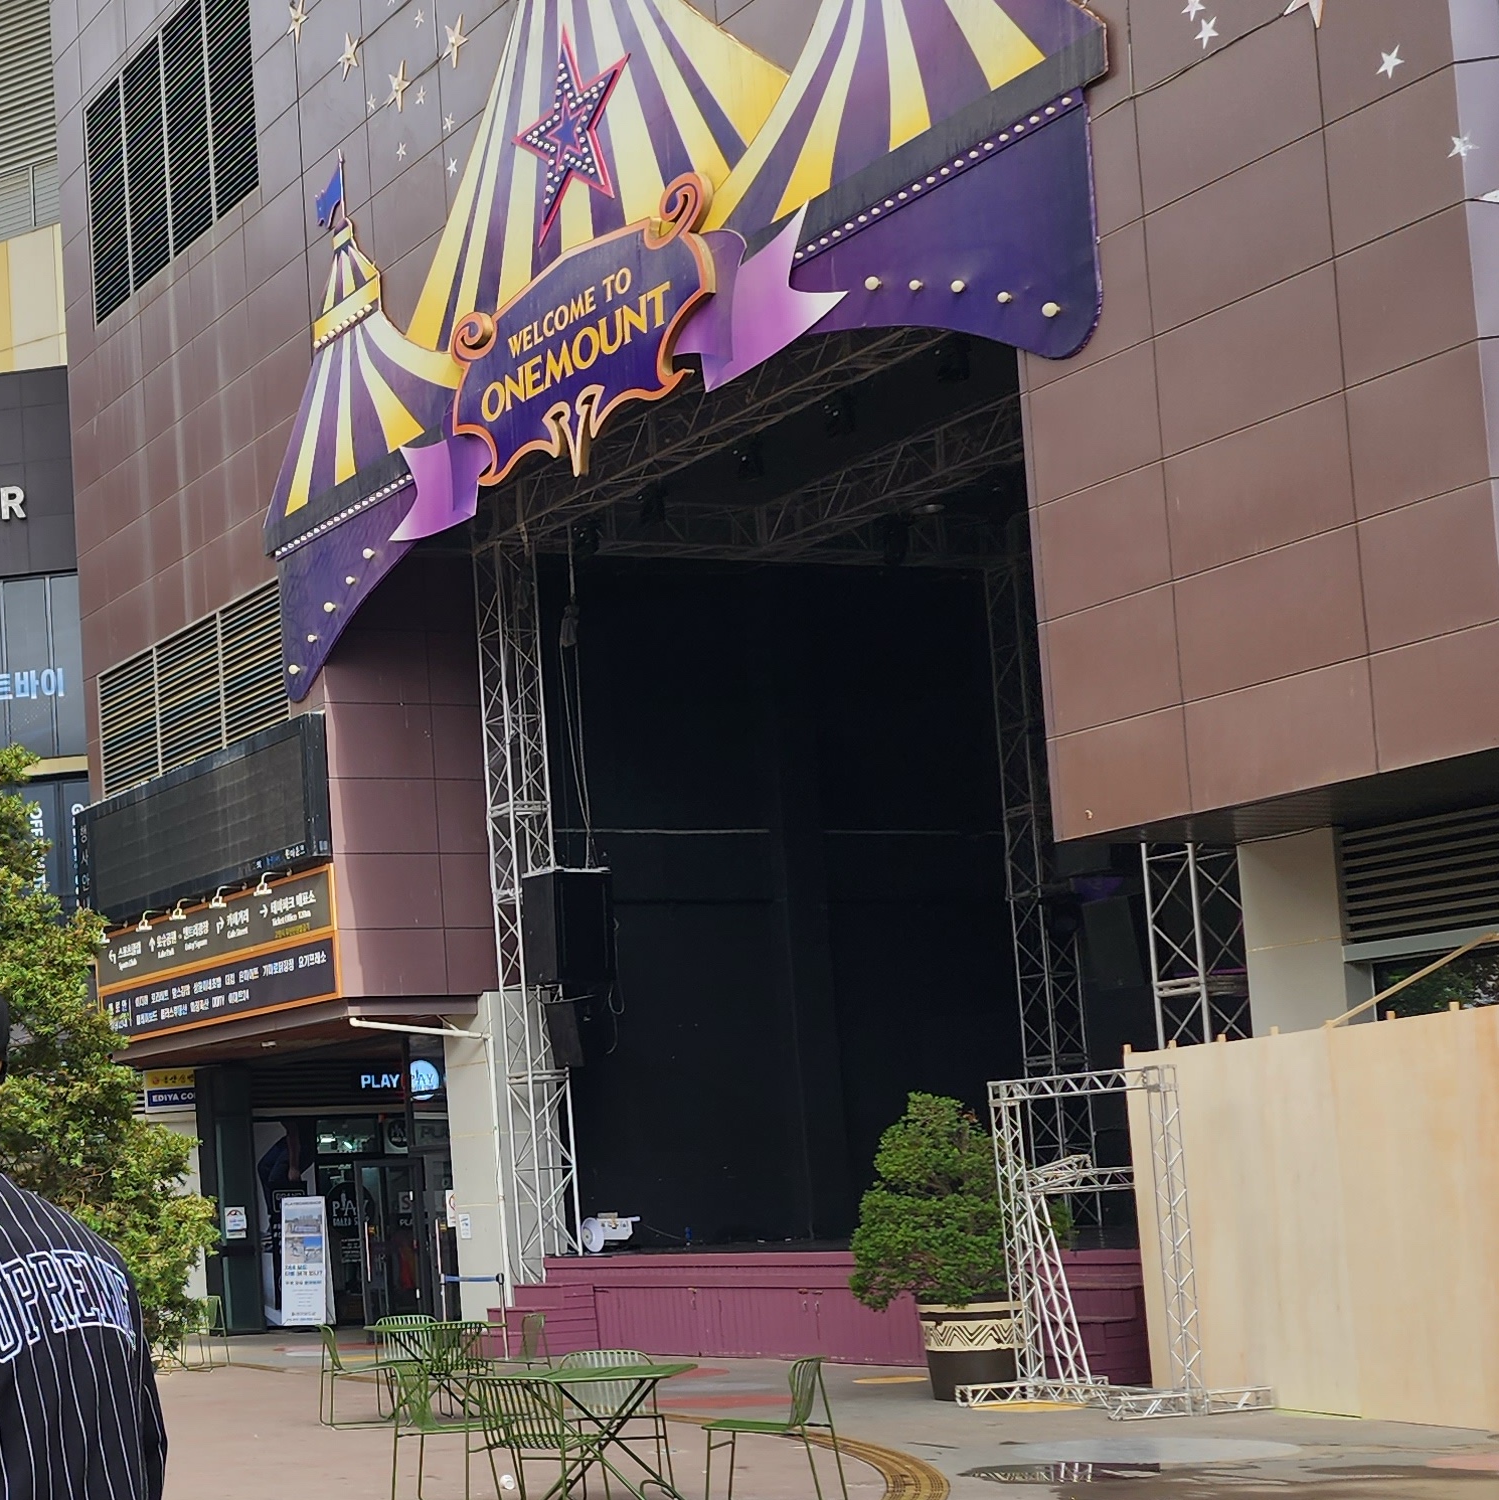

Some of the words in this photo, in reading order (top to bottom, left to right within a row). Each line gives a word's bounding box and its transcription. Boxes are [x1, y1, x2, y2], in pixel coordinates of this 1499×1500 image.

[508, 286, 595, 358] WELCOME
[602, 267, 632, 303] TO
[481, 281, 671, 422] ONEMOUNT
[152, 1093, 180, 1103] EDIYA
[360, 1072, 400, 1089] PLAY
